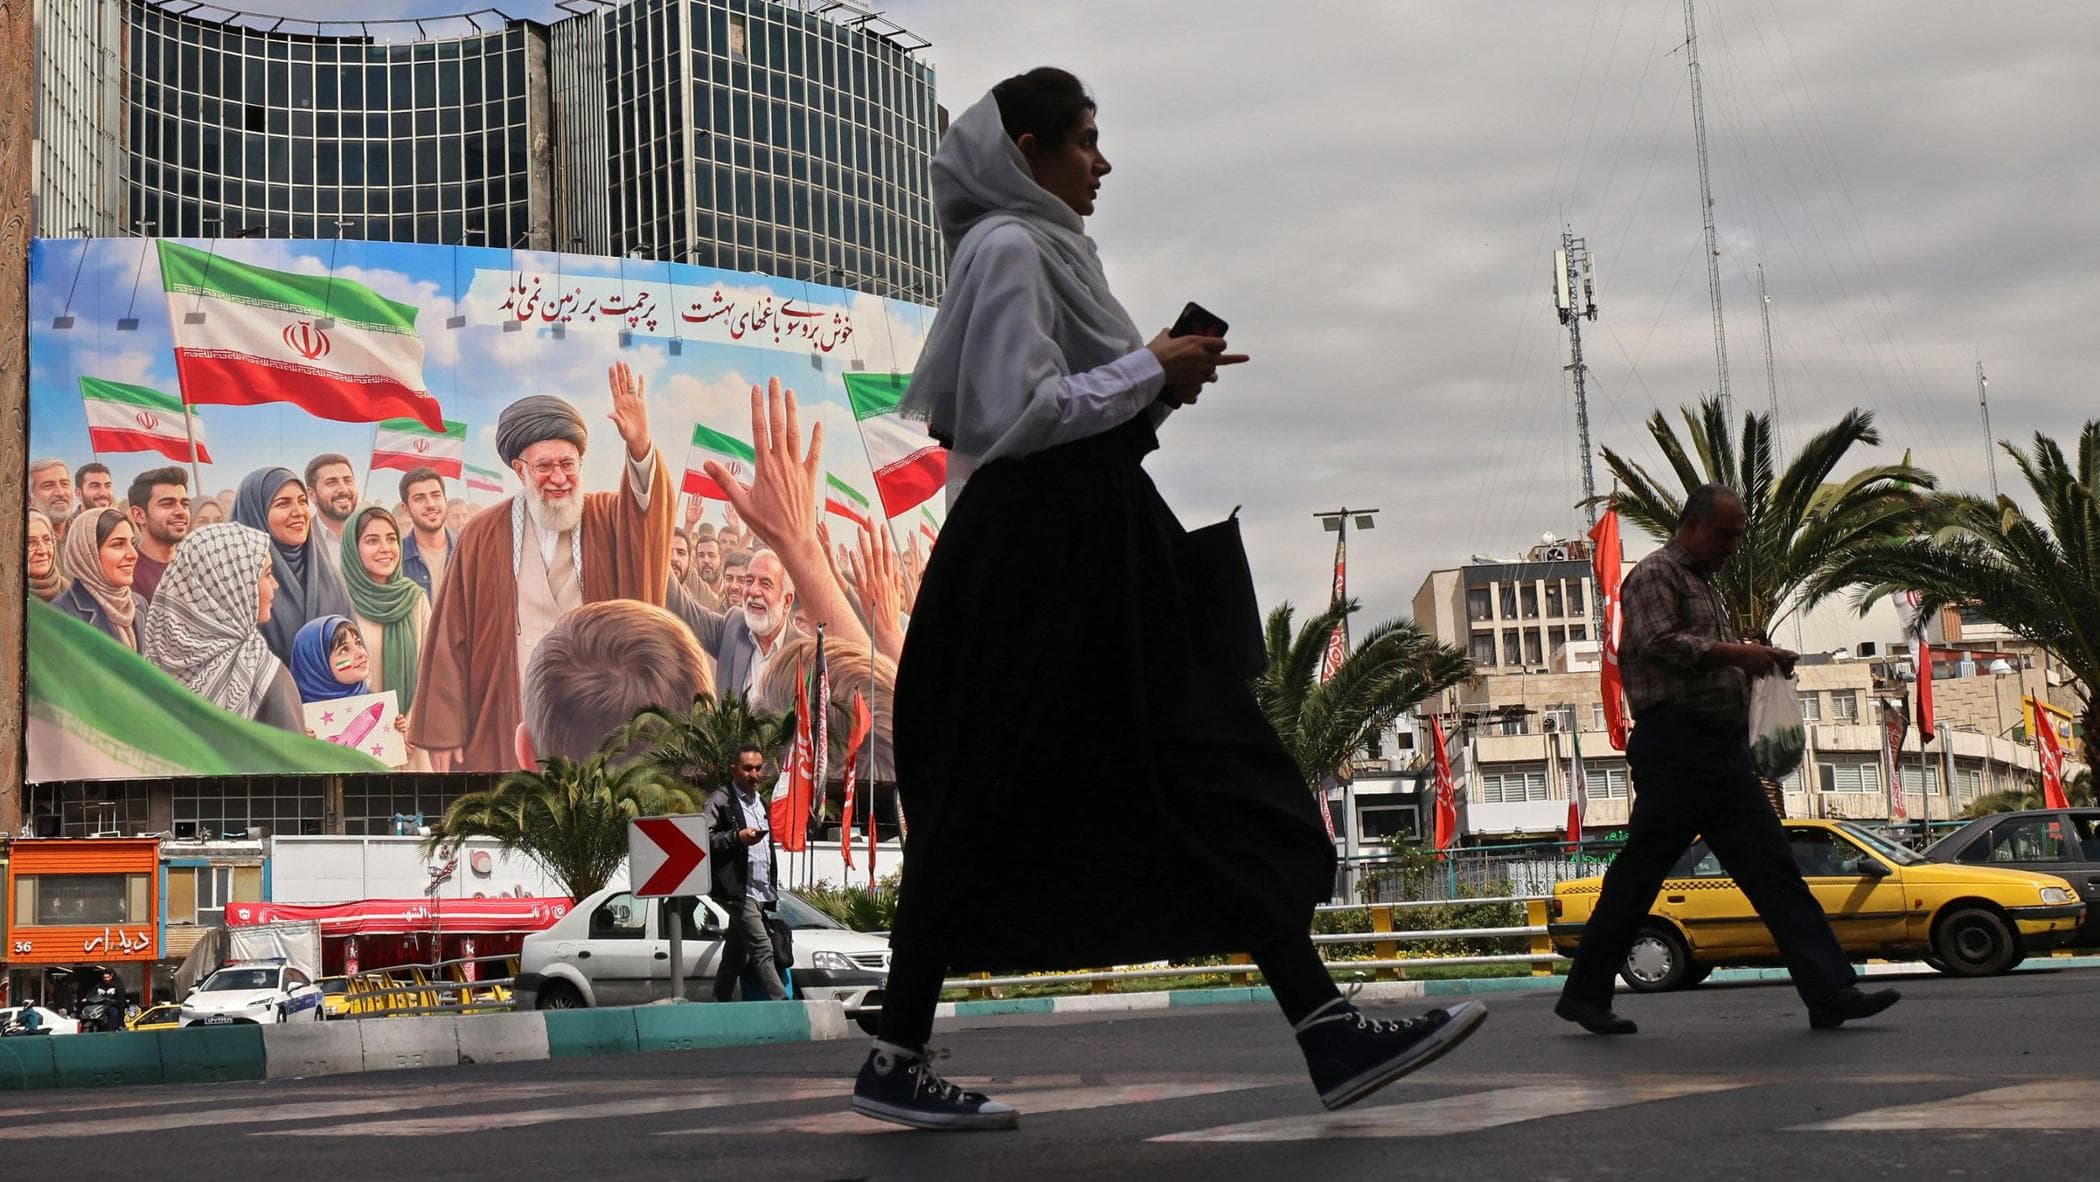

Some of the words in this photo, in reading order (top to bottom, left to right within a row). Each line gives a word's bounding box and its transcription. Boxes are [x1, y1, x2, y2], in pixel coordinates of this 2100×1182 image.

[600, 292, 657, 332] پرچمت
[682, 290, 735, 326] بهشت
[820, 312, 853, 352] خوش
[14, 941, 32, 953] 36
[84, 927, 149, 954] دیدار
